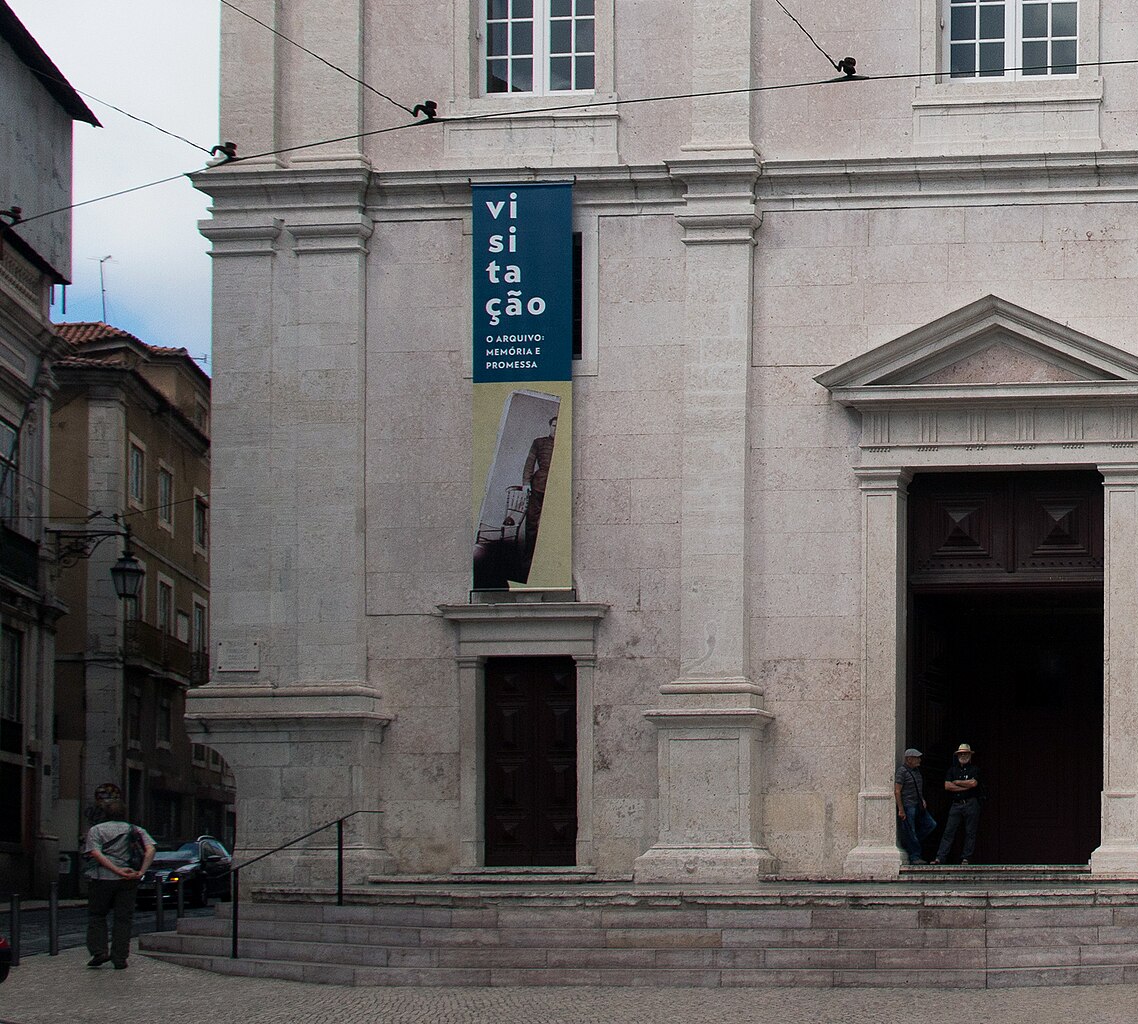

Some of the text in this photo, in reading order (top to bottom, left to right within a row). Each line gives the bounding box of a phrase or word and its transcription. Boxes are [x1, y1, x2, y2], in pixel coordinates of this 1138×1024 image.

[486, 193, 517, 219] vi
[489, 226, 516, 252] si
[486, 261, 520, 283] ta
[486, 291, 545, 325] ção
[496, 334, 544, 342] ARQUIVO:
[487, 347, 532, 356] MEMÓRIA
[486, 361, 537, 369] PROMESSA
